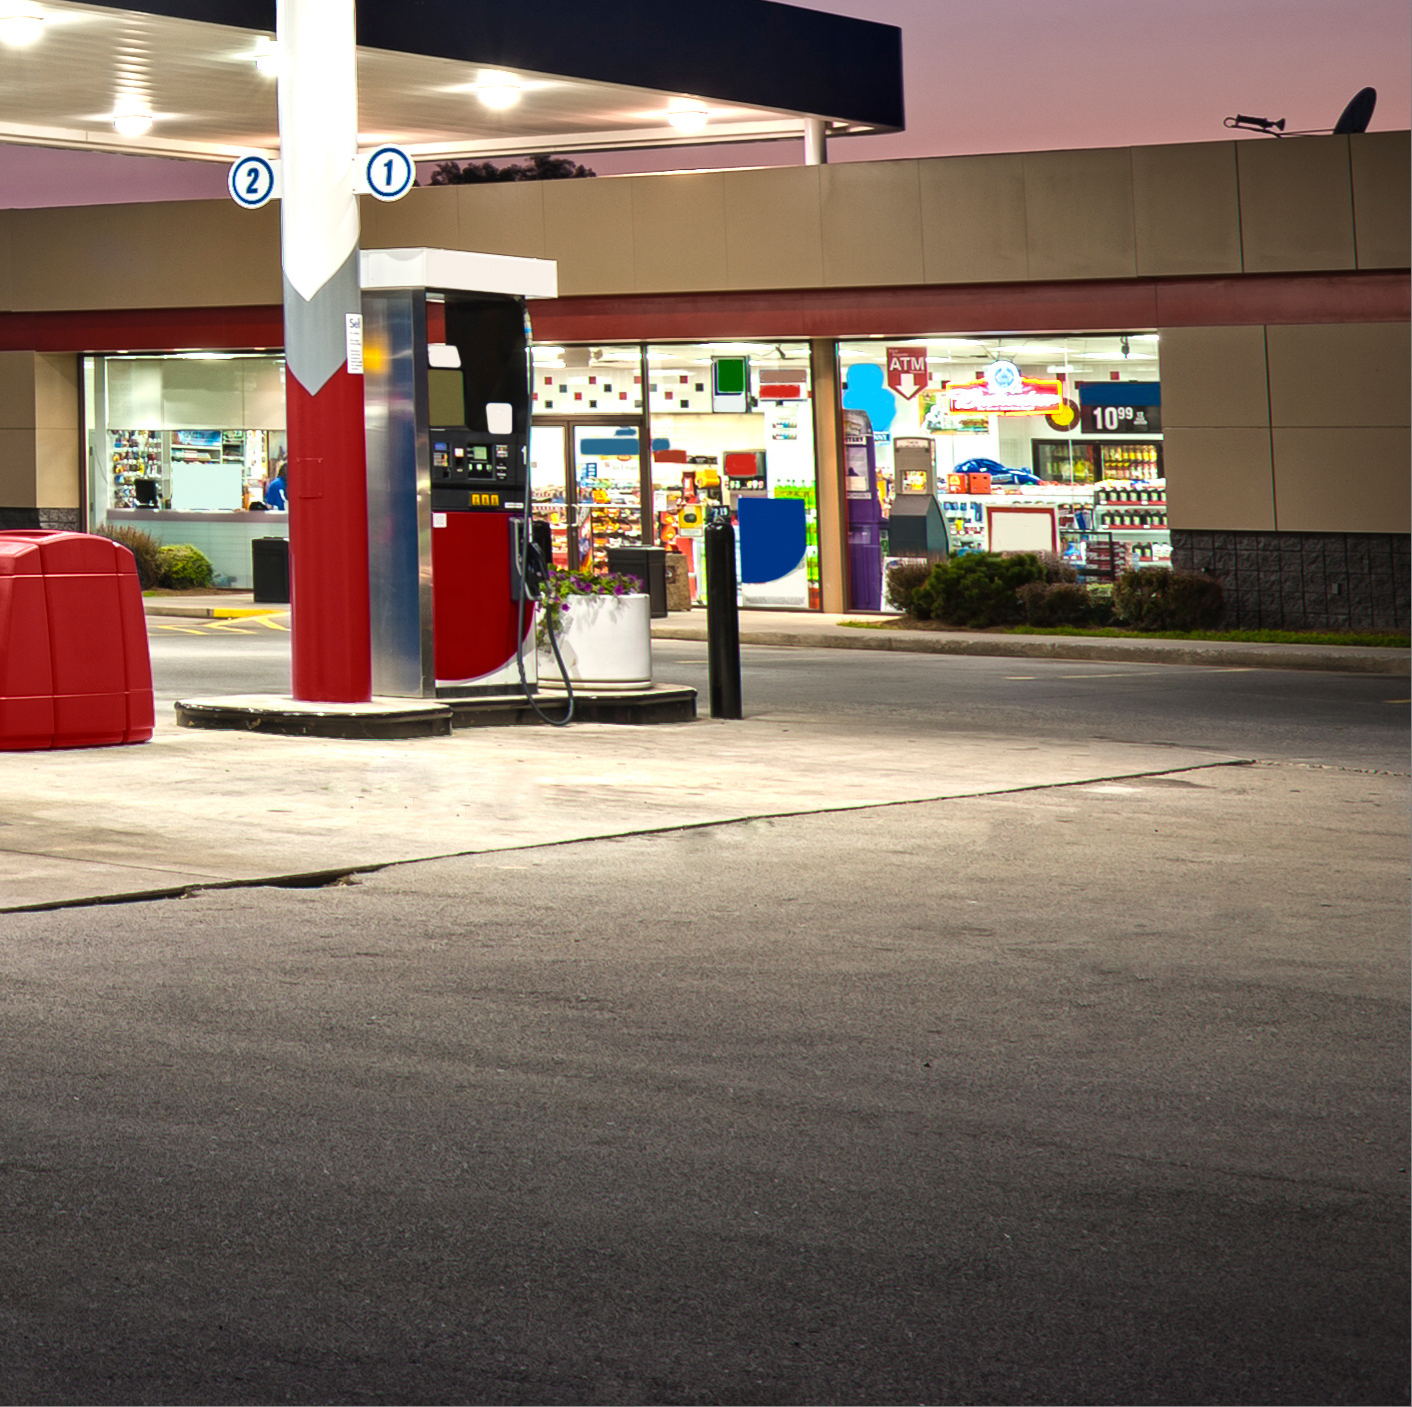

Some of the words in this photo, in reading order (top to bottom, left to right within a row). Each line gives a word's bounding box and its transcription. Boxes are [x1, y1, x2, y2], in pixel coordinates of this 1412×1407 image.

[246, 167, 260, 194] 2
[383, 159, 394, 186] 1
[889, 357, 925, 371] ATM
[521, 445, 527, 465] 1
